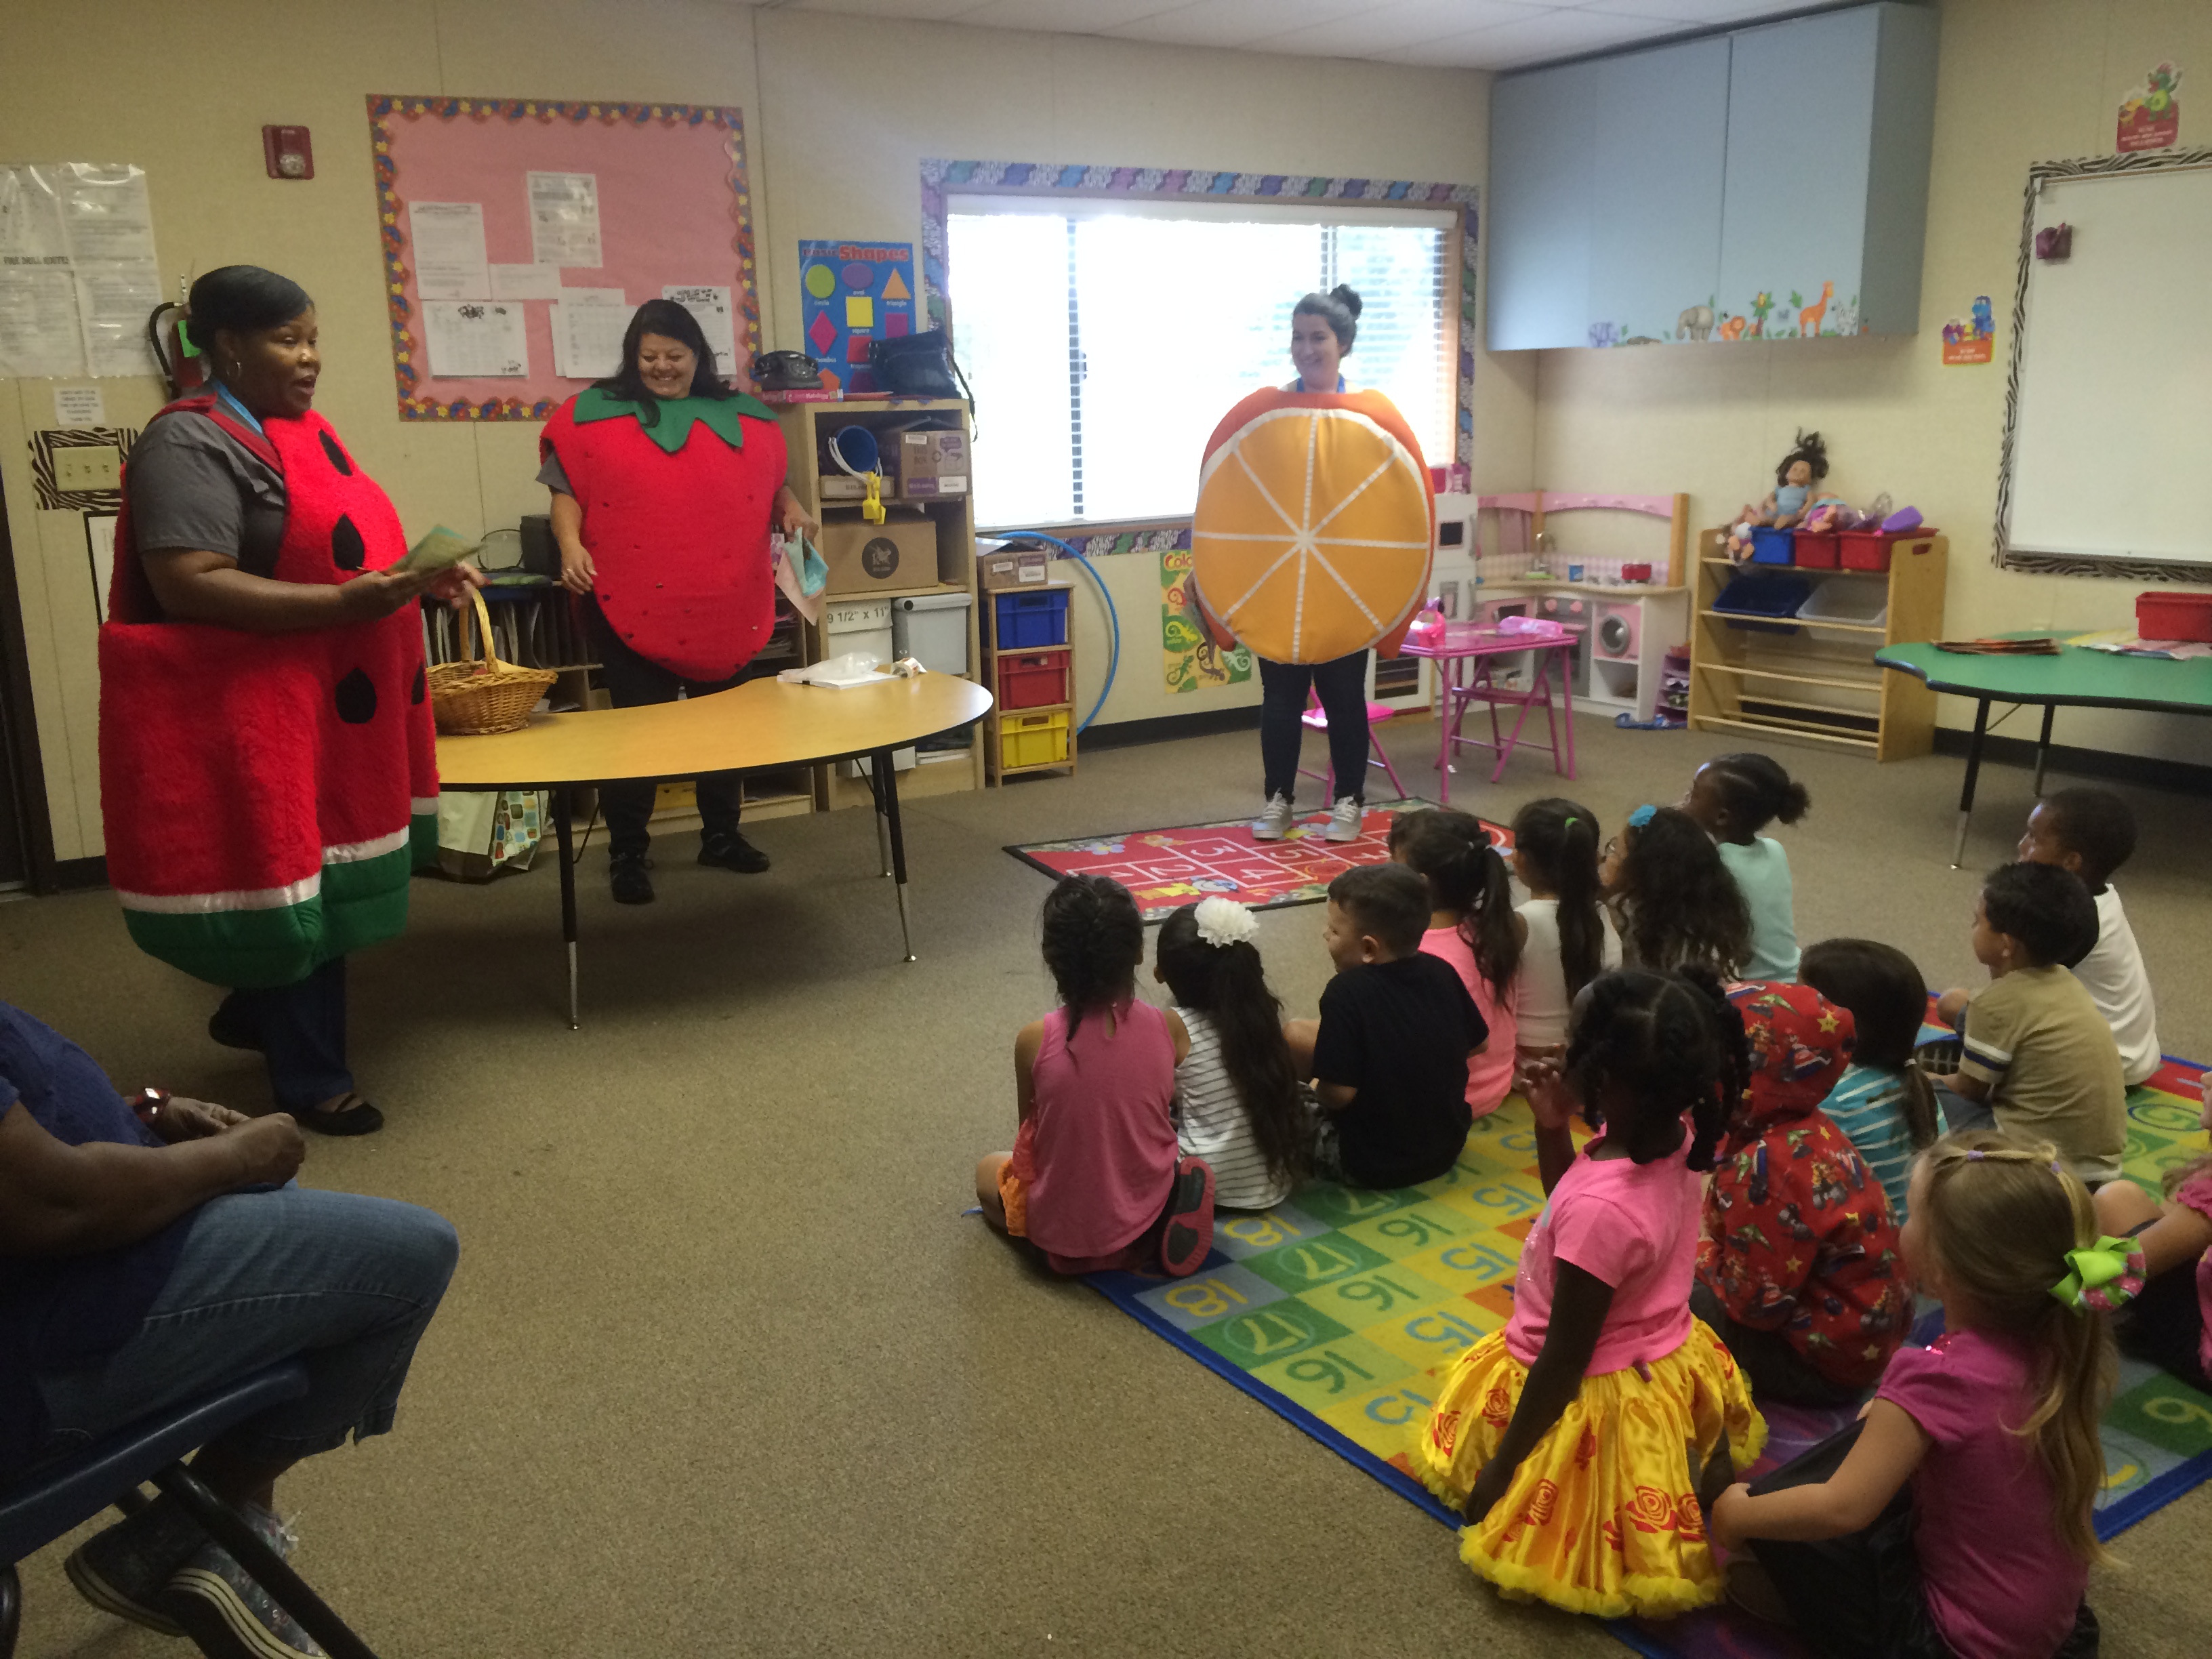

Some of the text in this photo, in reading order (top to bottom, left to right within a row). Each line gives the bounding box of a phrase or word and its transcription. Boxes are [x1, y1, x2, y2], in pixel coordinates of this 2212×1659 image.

[839, 245, 909, 263] Shapes
[1165, 553, 1193, 571] Colo
[827, 613, 834, 623] 9
[838, 611, 859, 622] 1/2"
[874, 607, 889, 617] 11"
[1190, 846, 1237, 857] 3
[1269, 848, 1319, 859] 5
[1150, 864, 1196, 876] 2
[1240, 869, 1286, 880] 4
[1472, 1183, 1544, 1216] 15
[1224, 1212, 1302, 1246] 18
[1377, 1213, 1454, 1246] 16
[1295, 1242, 1357, 1279] 17
[1439, 1242, 1518, 1281] 15
[1165, 1278, 1248, 1317] 18
[1337, 1275, 1420, 1312] 16
[1243, 1313, 1310, 1355] 17
[1286, 1350, 1375, 1395] 16
